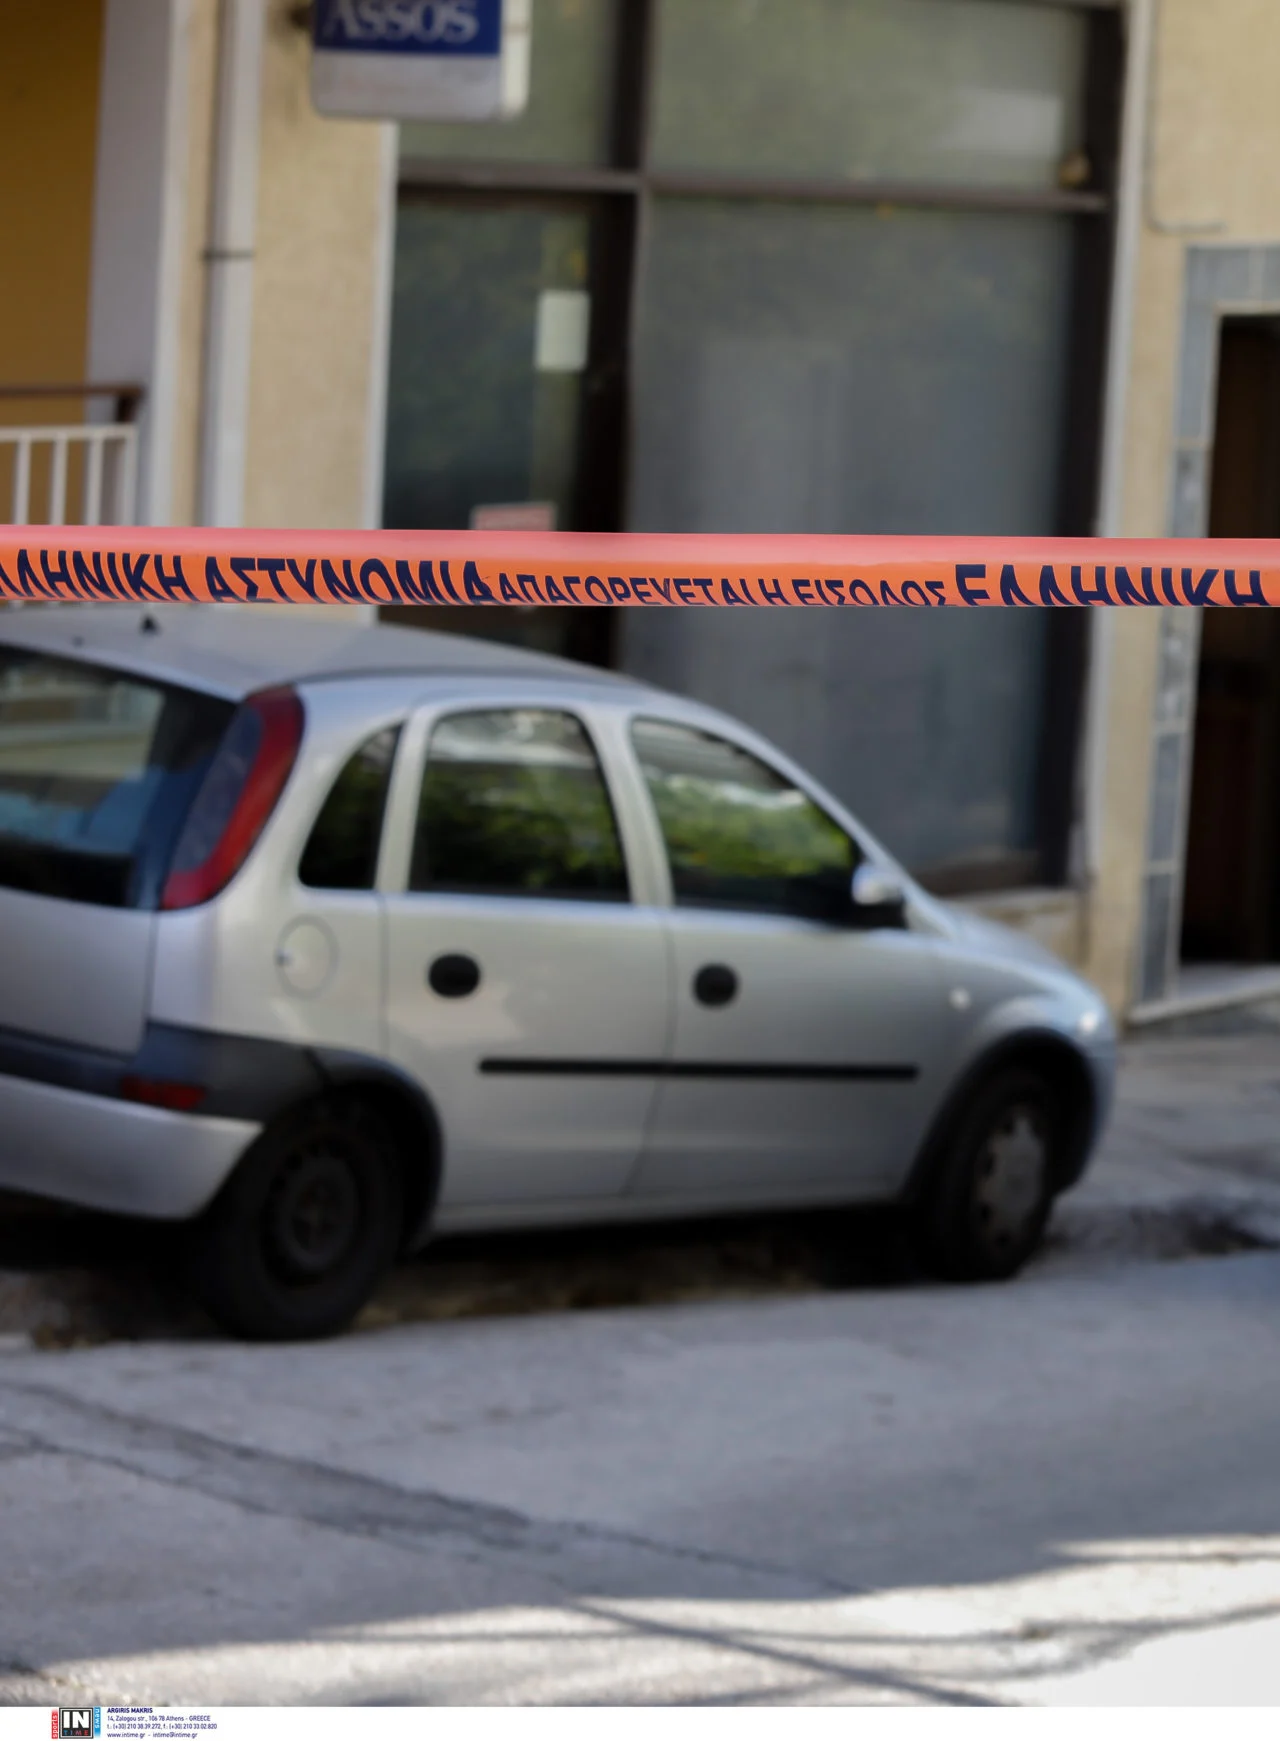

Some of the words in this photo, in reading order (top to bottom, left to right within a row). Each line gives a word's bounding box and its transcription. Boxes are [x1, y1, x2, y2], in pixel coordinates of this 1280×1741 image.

[204, 556, 500, 606] ΑΣΤΥΝΟΜΙΑ
[499, 573, 759, 605] ΑΠΑΓΟΡΕΥΕΤΑΙ
[791, 579, 957, 606] ΕΙΣΟΔΟΣ
[955, 564, 1272, 606] ΕΛΛΗΝΙΚΗ
